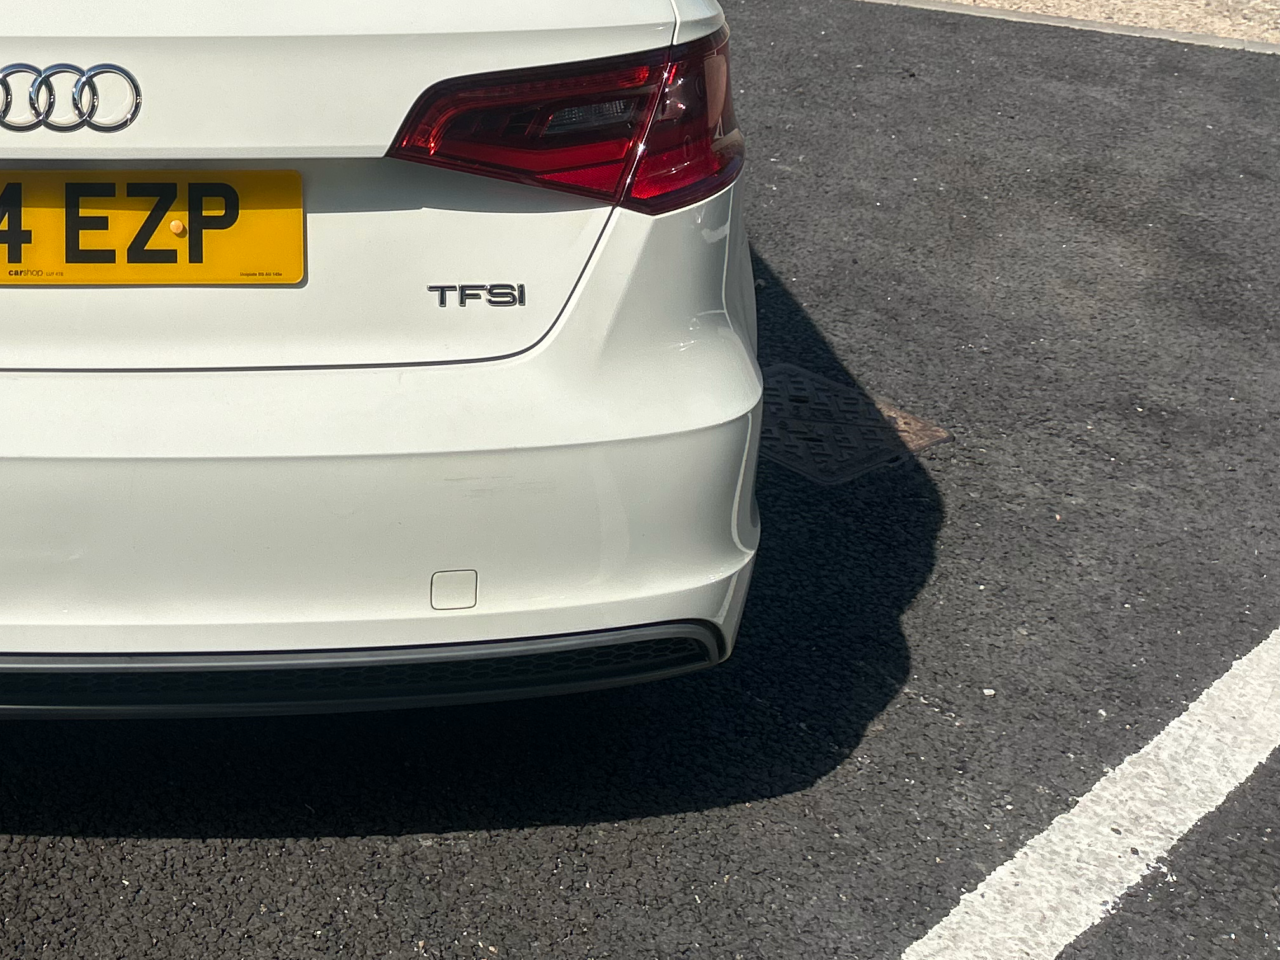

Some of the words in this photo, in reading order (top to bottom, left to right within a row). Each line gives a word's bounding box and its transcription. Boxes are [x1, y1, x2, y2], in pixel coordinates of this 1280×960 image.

[64, 182, 240, 265] EZP
[8, 268, 44, 277] carshop
[426, 283, 526, 308] TFSI
